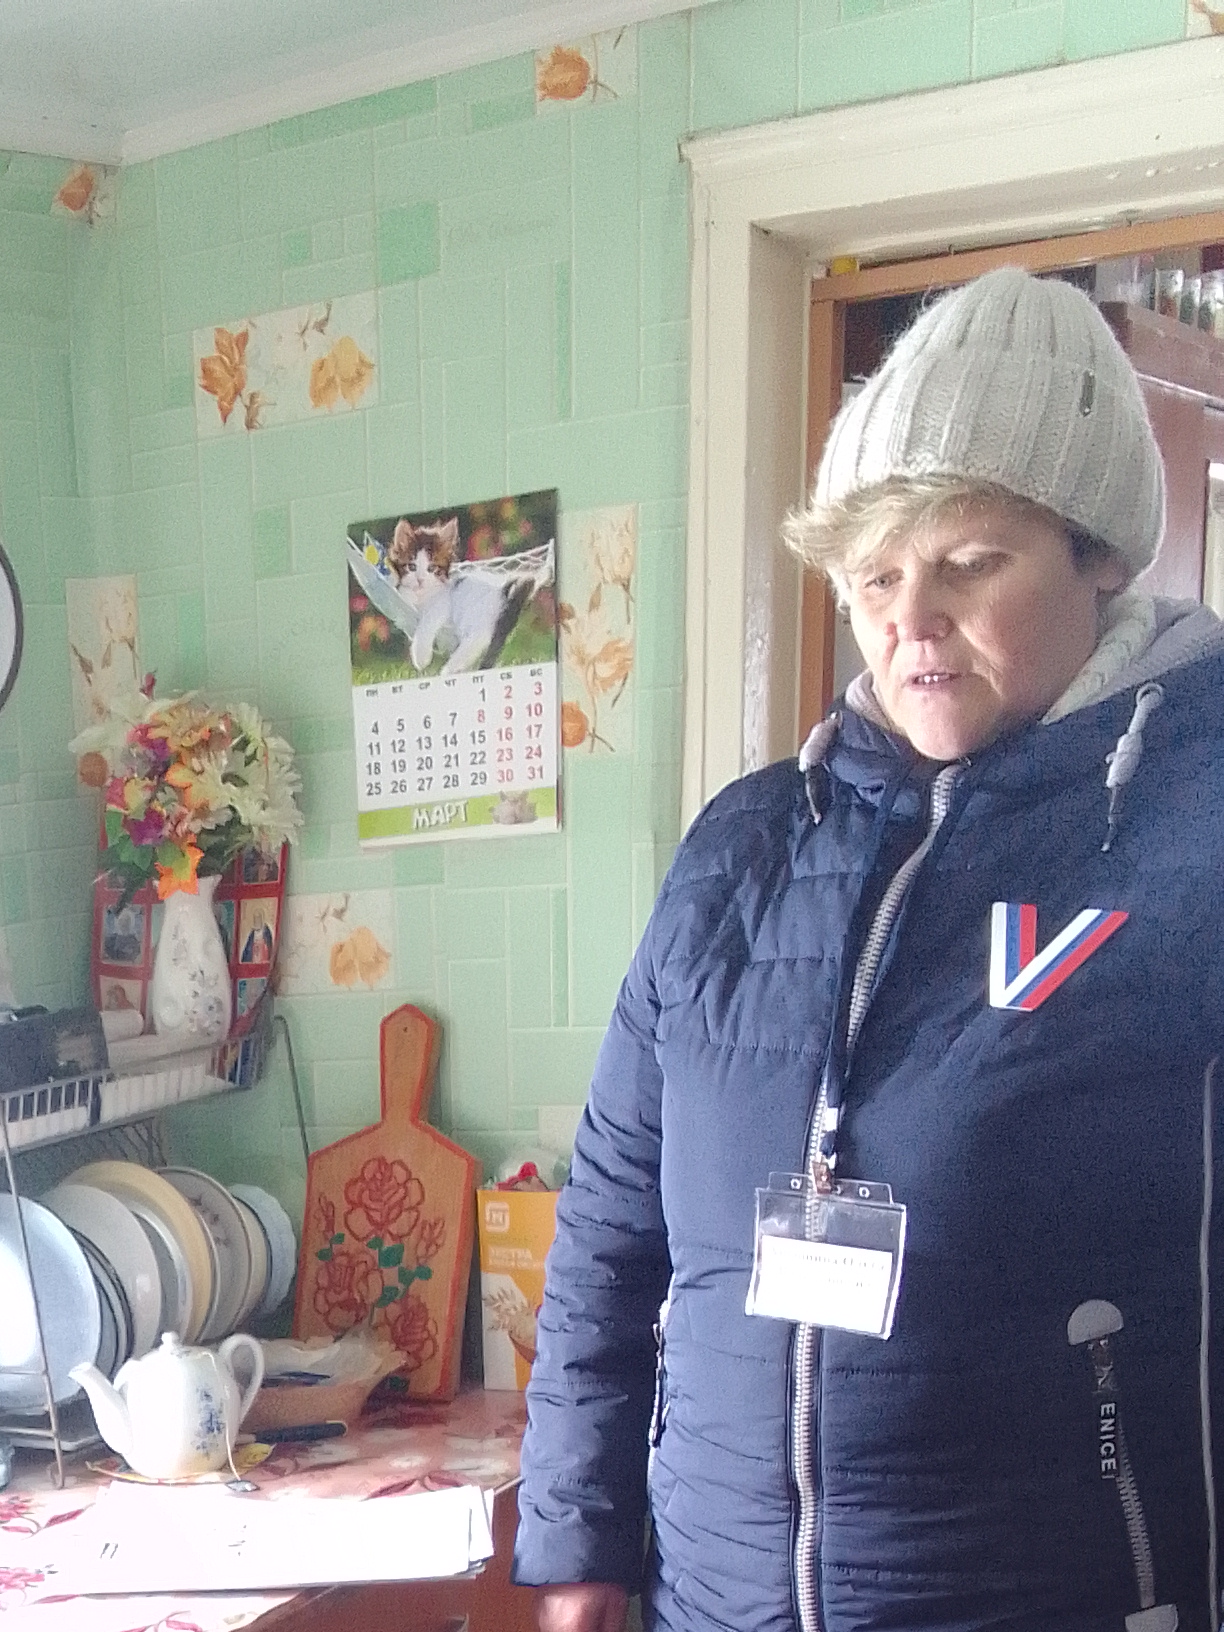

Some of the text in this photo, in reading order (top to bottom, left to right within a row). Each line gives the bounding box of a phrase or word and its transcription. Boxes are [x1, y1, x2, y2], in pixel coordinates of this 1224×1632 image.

[392, 685, 403, 694] ВТ
[419, 682, 430, 690] СР
[445, 679, 456, 687] ЧТ
[472, 676, 484, 684] ПТ
[500, 672, 512, 680] СБ
[479, 682, 543, 702] 1 2 3
[372, 703, 543, 735] 4 5 6 7 8 9 10
[368, 724, 543, 756] 11 12 13 14 15 16 17
[366, 745, 542, 775] 18 19 20 21 22 23 24
[366, 766, 544, 796] 25 26 27 28 29 30 31
[413, 801, 470, 830] МАРТ
